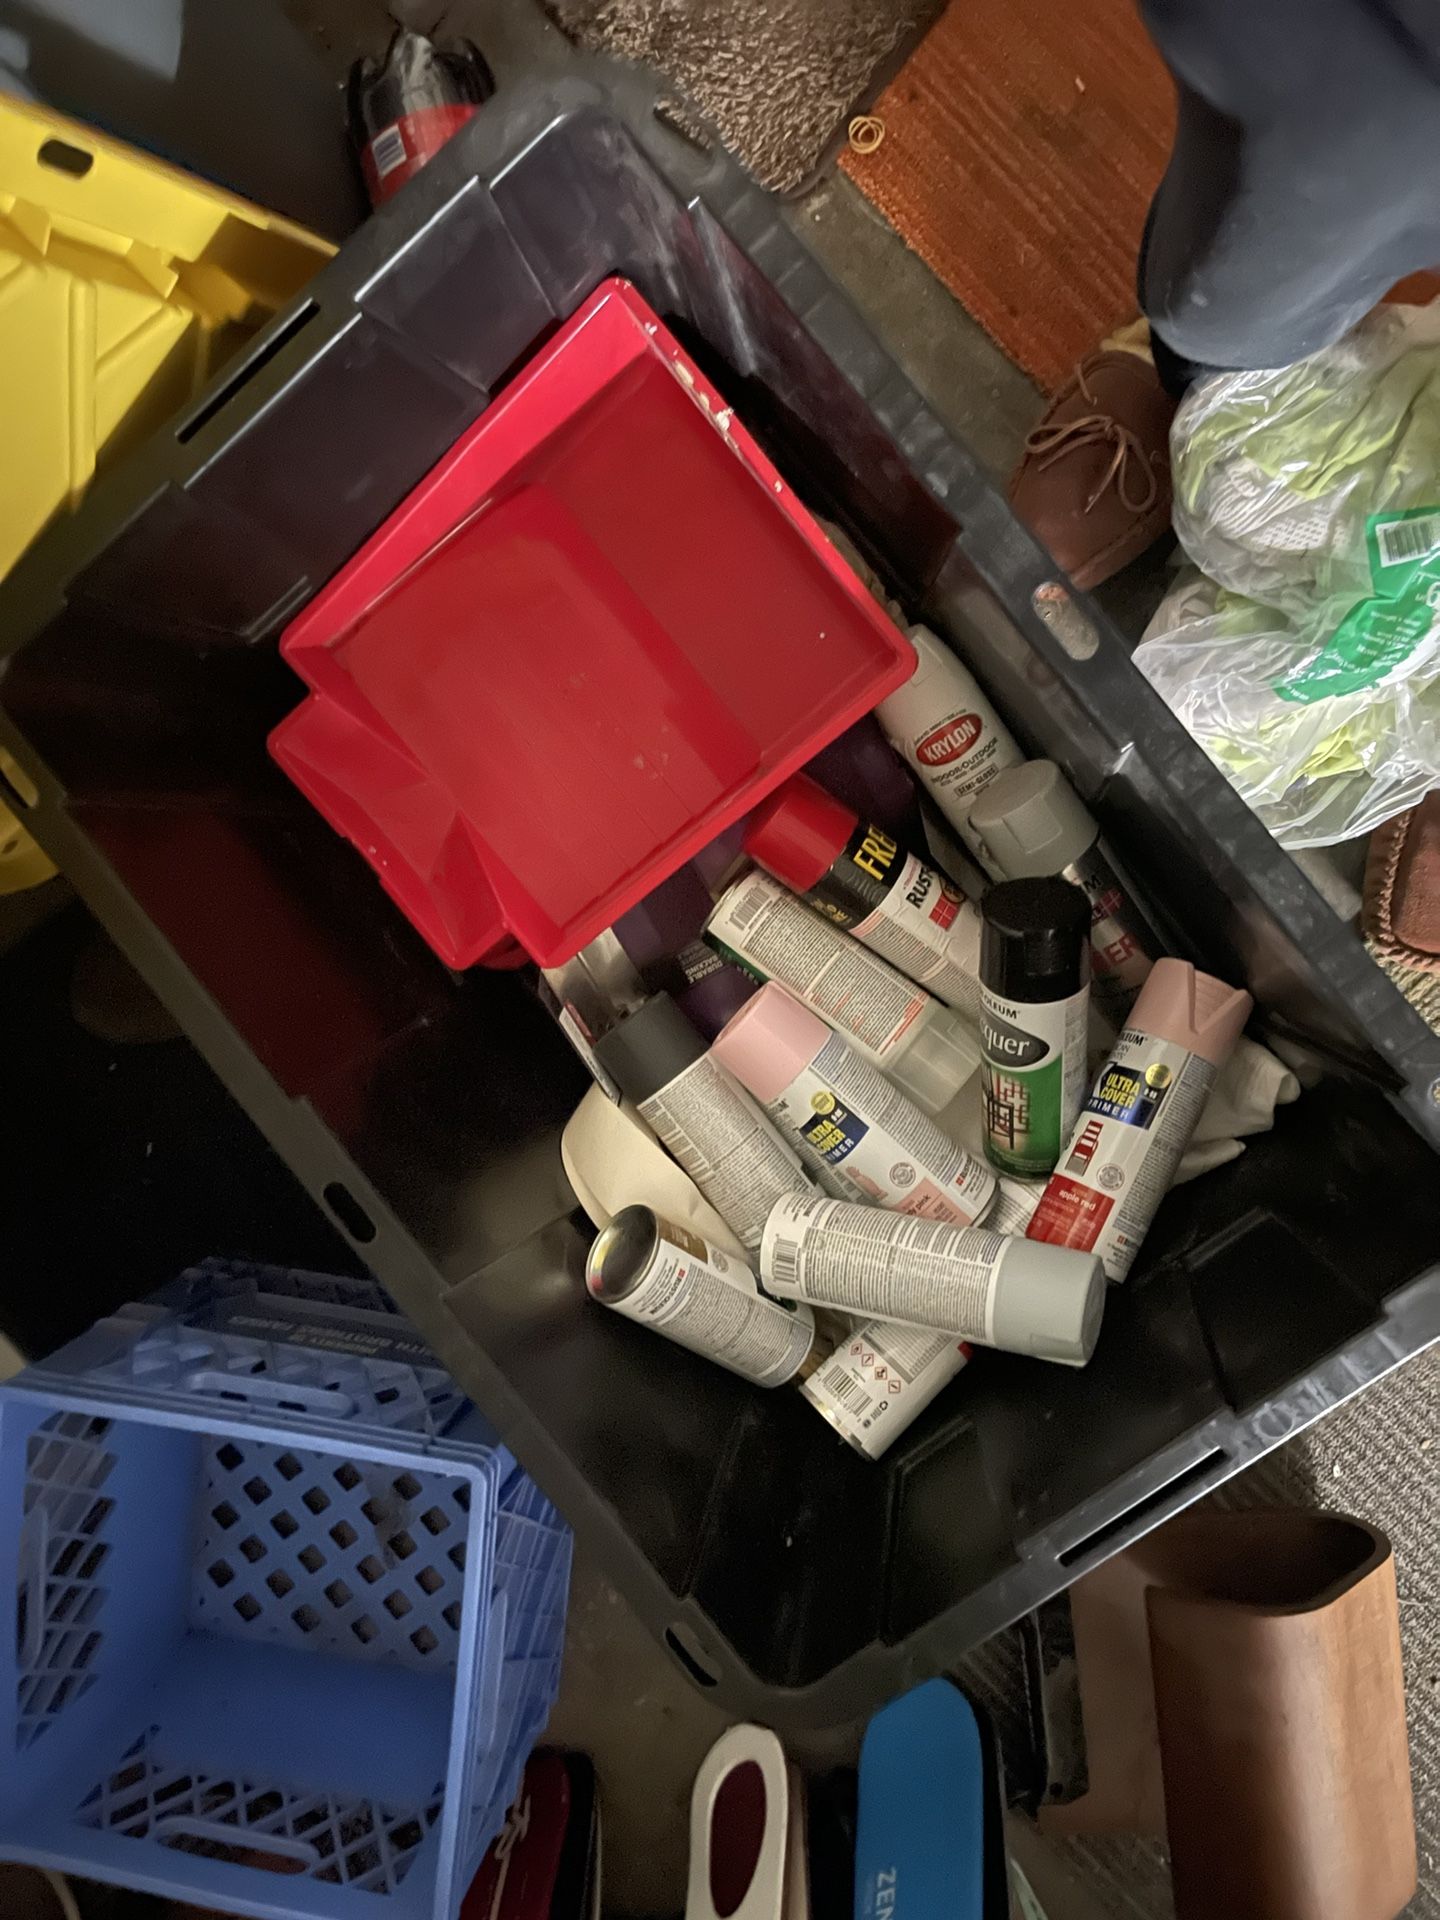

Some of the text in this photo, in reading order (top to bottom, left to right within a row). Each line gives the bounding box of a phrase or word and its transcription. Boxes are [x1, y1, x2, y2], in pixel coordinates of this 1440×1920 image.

[923, 719, 976, 762] KRYLON
[684, 954, 718, 977] BACKING
[687, 960, 723, 984] DURABLE
[1105, 1072, 1141, 1095] ULTRA
[1098, 1086, 1136, 1108] COVER
[1057, 1189, 1096, 1211] apple red
